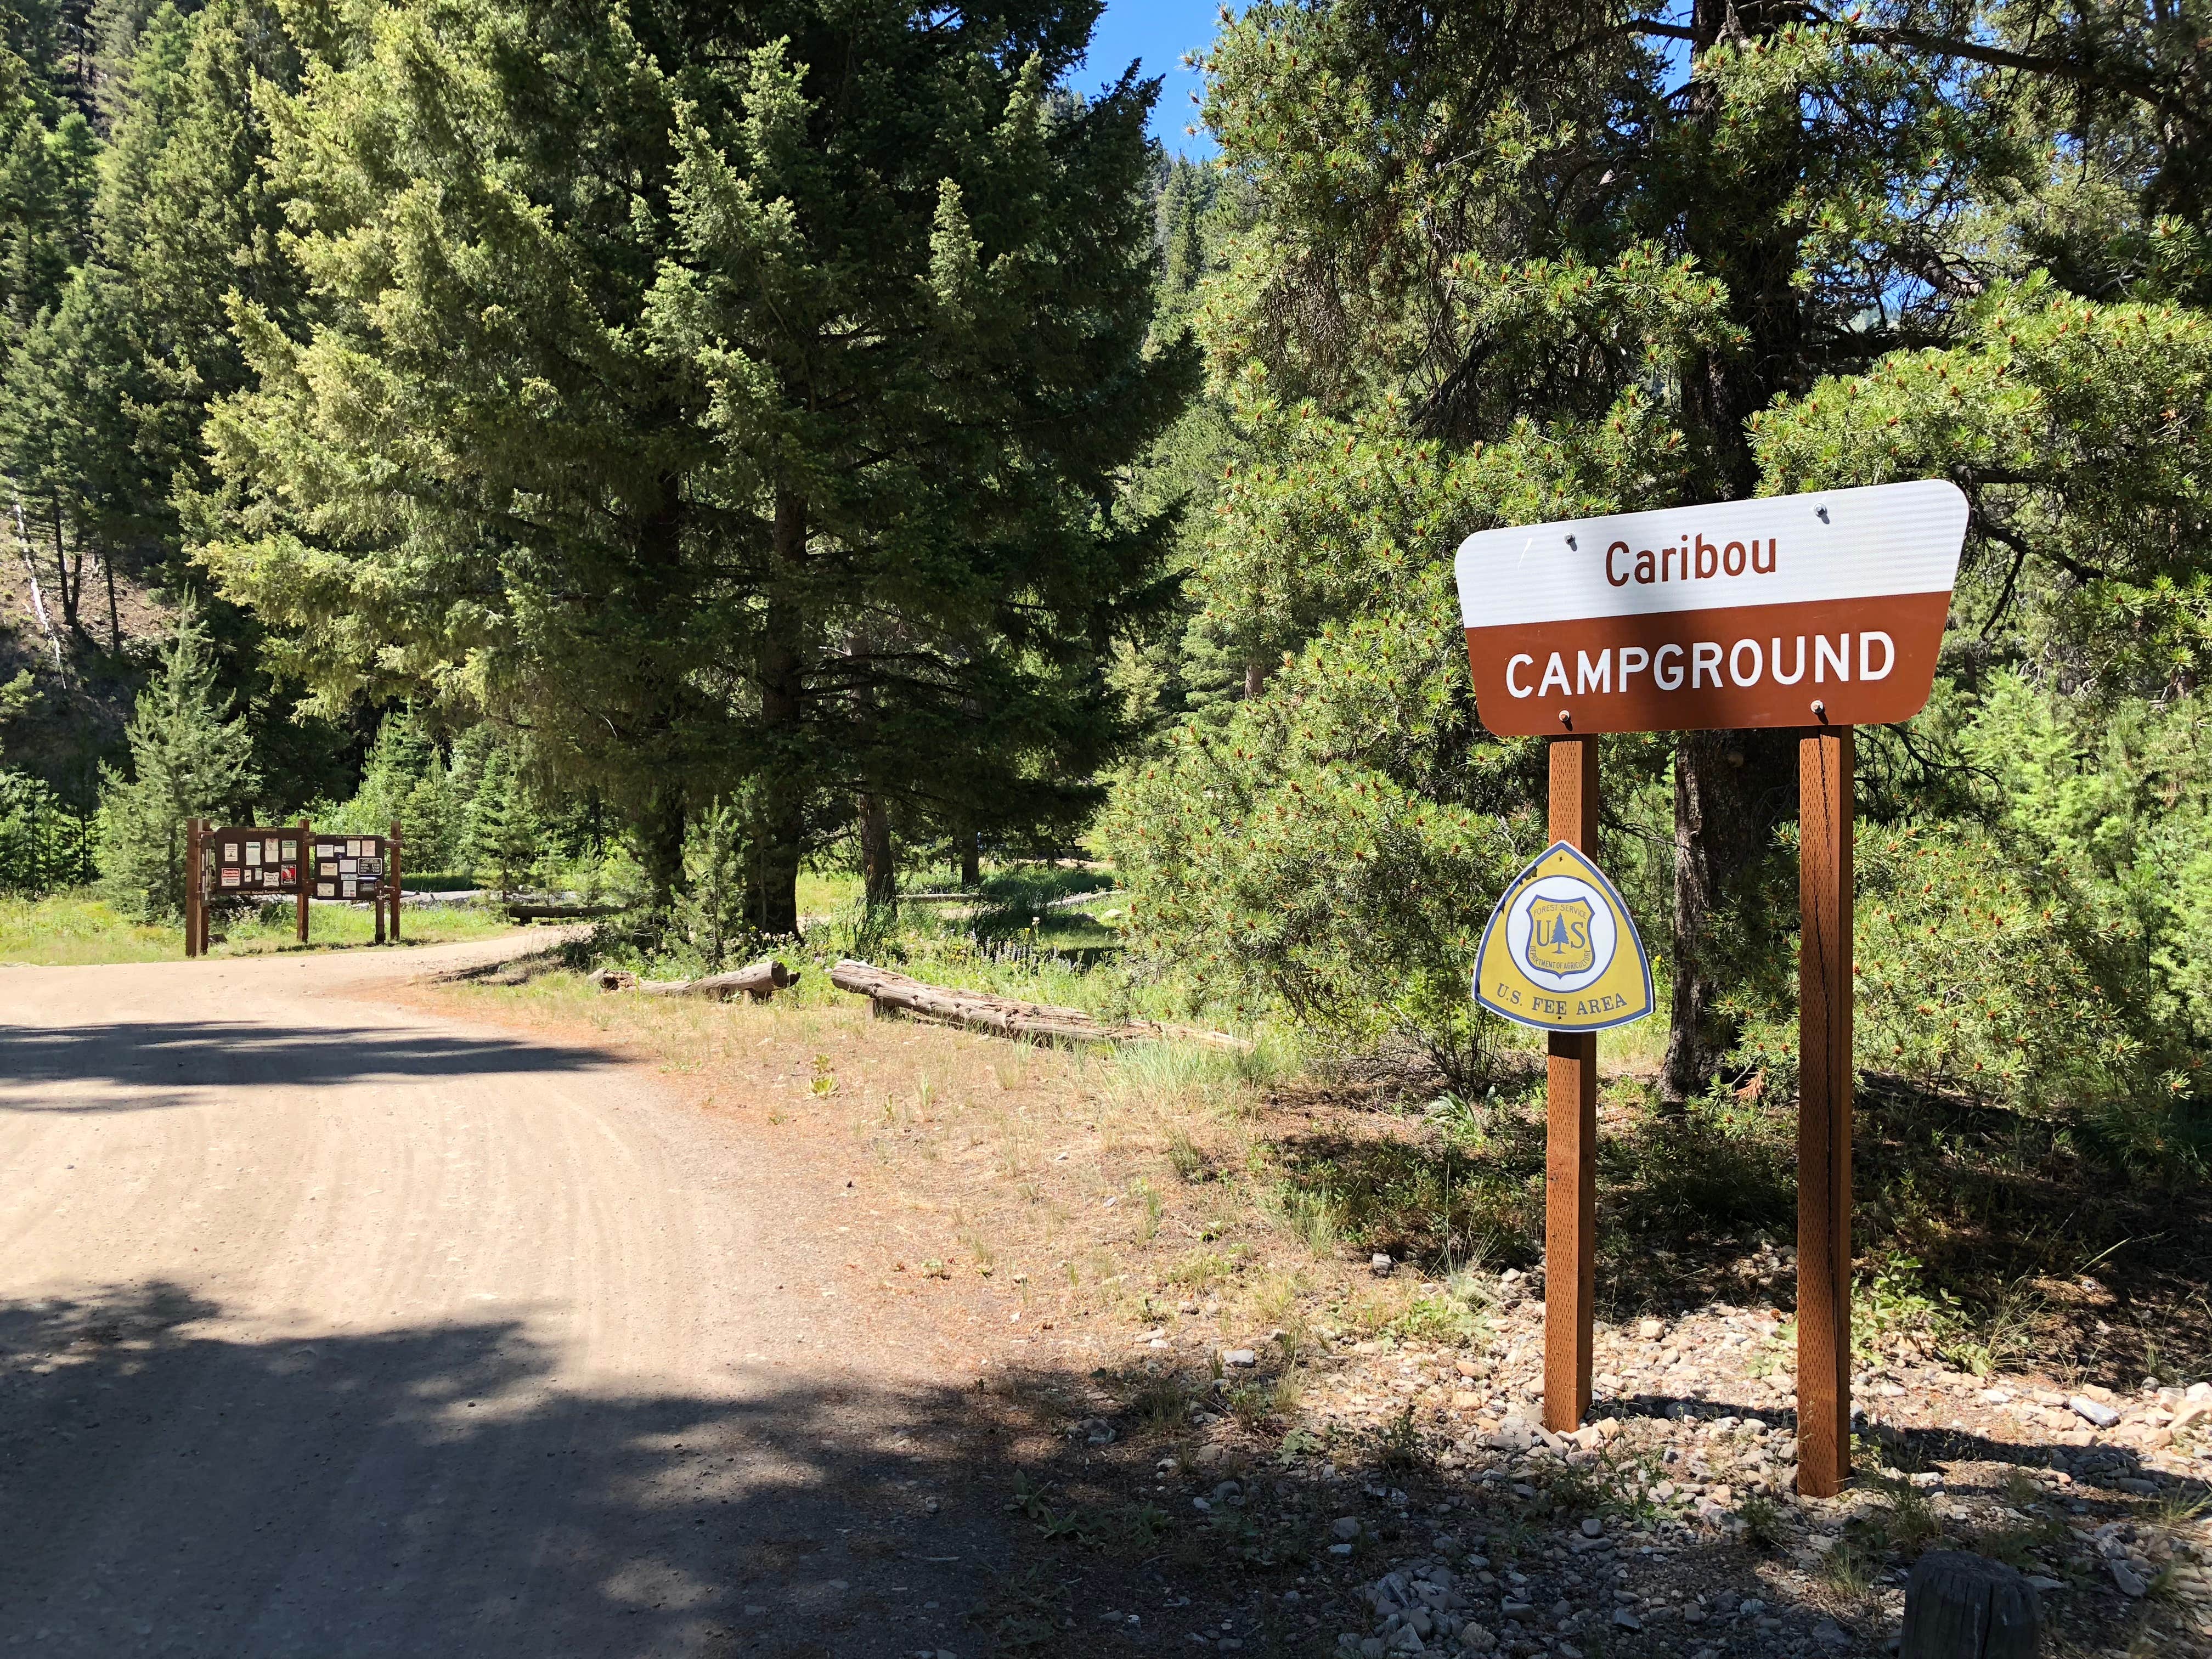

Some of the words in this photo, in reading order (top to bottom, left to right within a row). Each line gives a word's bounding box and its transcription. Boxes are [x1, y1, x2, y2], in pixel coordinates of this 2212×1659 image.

[1606, 533, 1777, 587] Caribou
[1506, 631, 1895, 699] CAMPGROUND
[1533, 904, 1558, 917] FOREST
[1560, 904, 1587, 919] SERVICE
[1536, 920, 1551, 947] U
[1571, 922, 1585, 949] S
[1530, 945, 1556, 969] DEPARTMENT
[1564, 949, 1591, 969] AGRICULTURE
[1497, 983, 1522, 1006] U.S.
[1531, 996, 1567, 1015] FEE
[1576, 992, 1628, 1015] AREA
